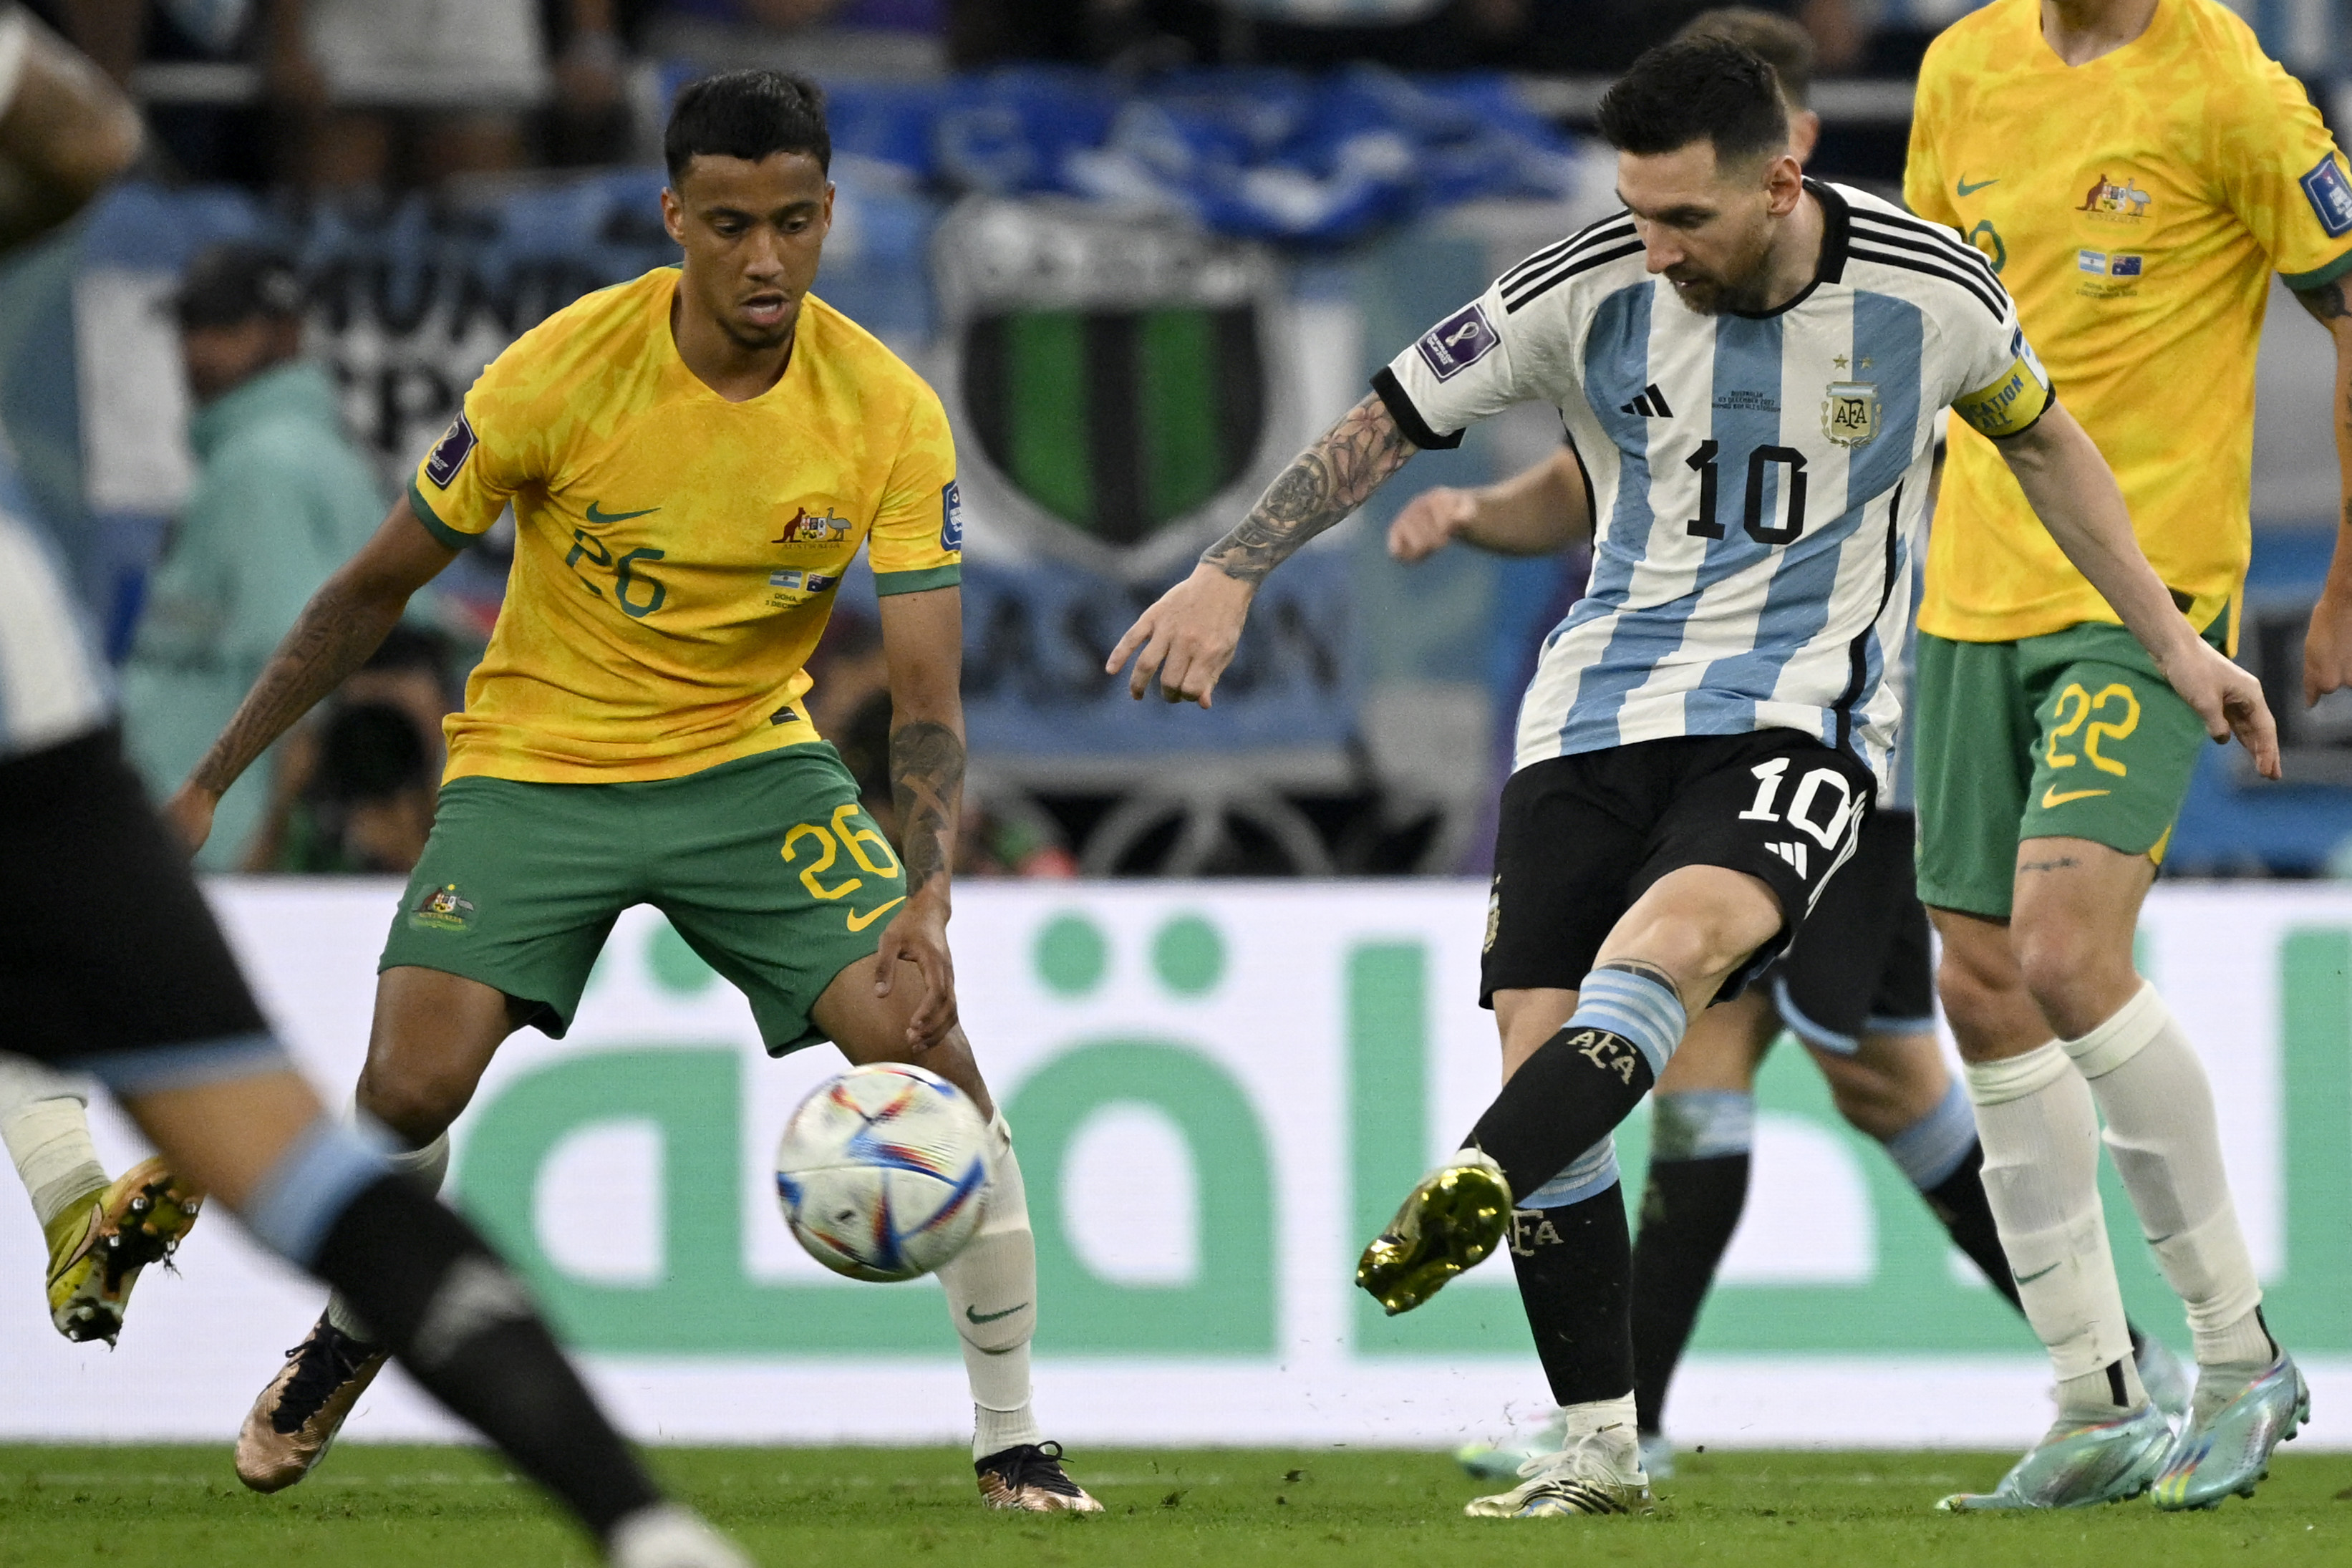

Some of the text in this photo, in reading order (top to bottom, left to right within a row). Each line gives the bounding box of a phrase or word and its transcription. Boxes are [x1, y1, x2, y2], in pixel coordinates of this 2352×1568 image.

[1834, 397, 1867, 429] AFA
[1685, 440, 1808, 545] 10
[566, 528, 666, 618] 26
[2046, 683, 2141, 777] 22
[1738, 757, 1852, 851] 10
[780, 803, 899, 900] 26
[1567, 1029, 1637, 1085] AFA
[1506, 1209, 1564, 1257] FA
